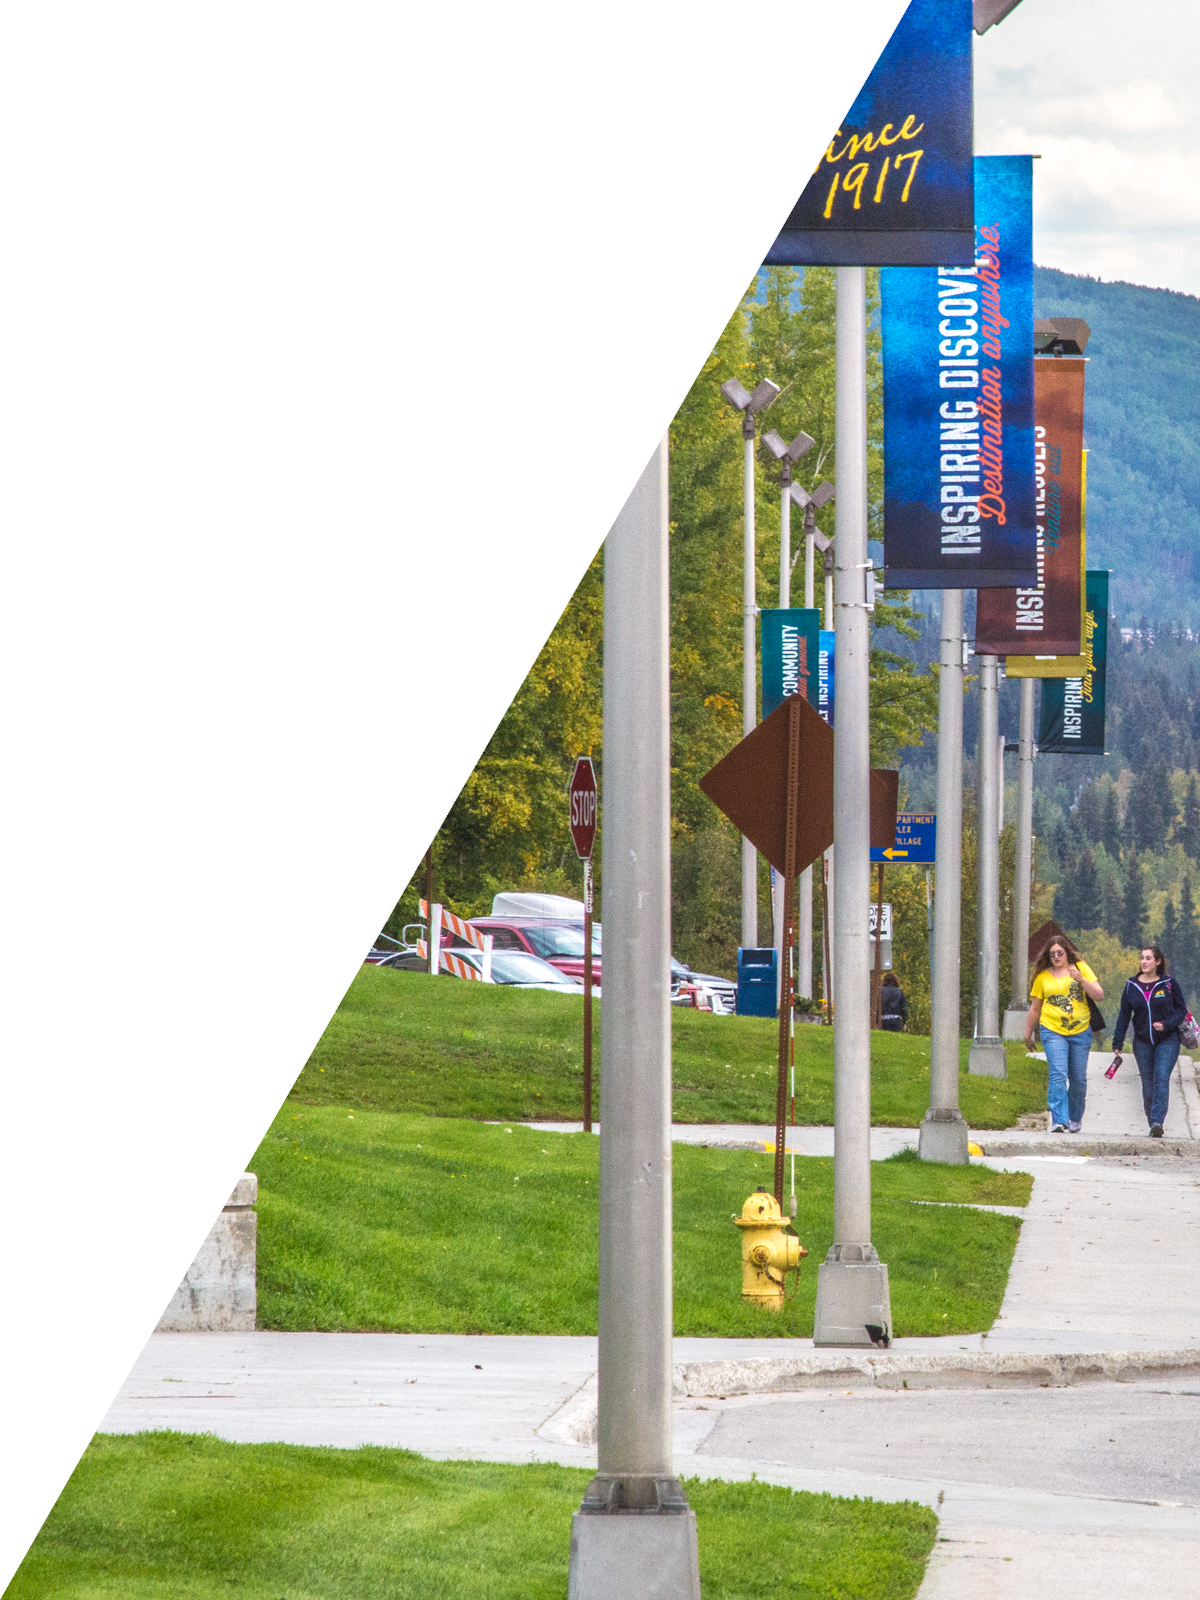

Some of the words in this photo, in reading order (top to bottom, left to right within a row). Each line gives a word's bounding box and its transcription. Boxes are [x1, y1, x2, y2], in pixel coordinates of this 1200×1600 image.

[809, 114, 924, 175] since
[823, 149, 924, 219] 1917
[938, 225, 979, 388] DISCOVE
[939, 401, 981, 555] INSPIRING
[976, 365, 1006, 525] Destination
[1042, 479, 1062, 555] Venture
[782, 624, 798, 697] COMMUNITY
[362, 770, 409, 782] KUSKOKWIM
[572, 790, 595, 826] STOP
[896, 816, 934, 824] PARTMENT
